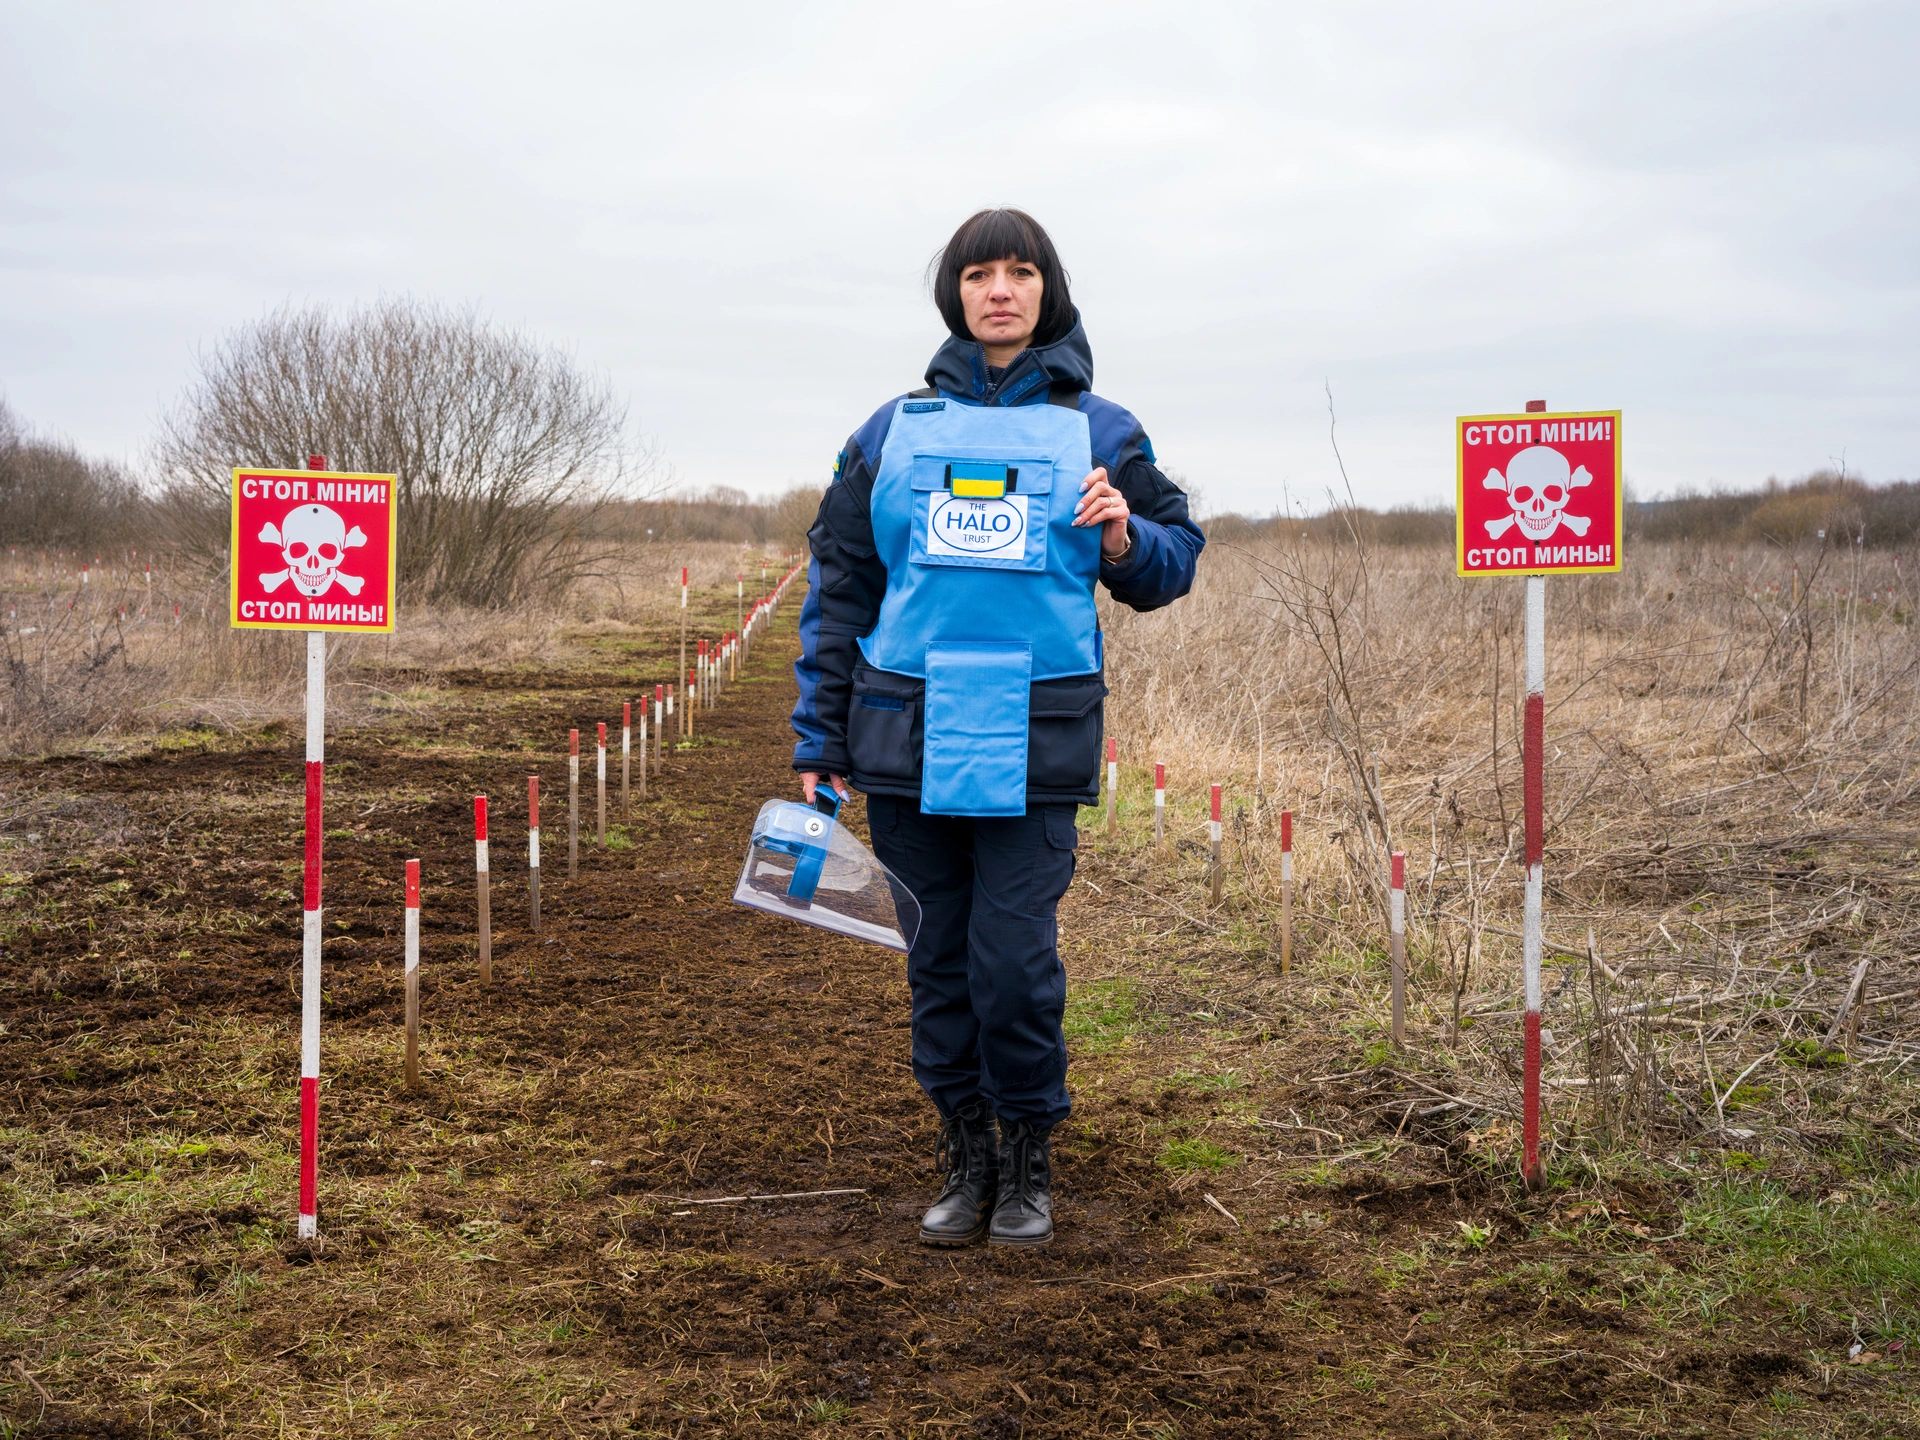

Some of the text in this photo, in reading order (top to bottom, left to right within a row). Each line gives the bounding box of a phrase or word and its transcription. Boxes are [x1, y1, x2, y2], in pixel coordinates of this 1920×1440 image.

[1465, 421, 1611, 446] СТОП МІНИ!
[242, 479, 386, 504] СТОП МІНИ!
[969, 502, 987, 511] THE
[946, 511, 1011, 533] HALO
[963, 534, 992, 544] TRUST
[1467, 545, 1611, 566] СТОП МИНЫ!
[241, 600, 384, 623] СТОП МИНЫ!
